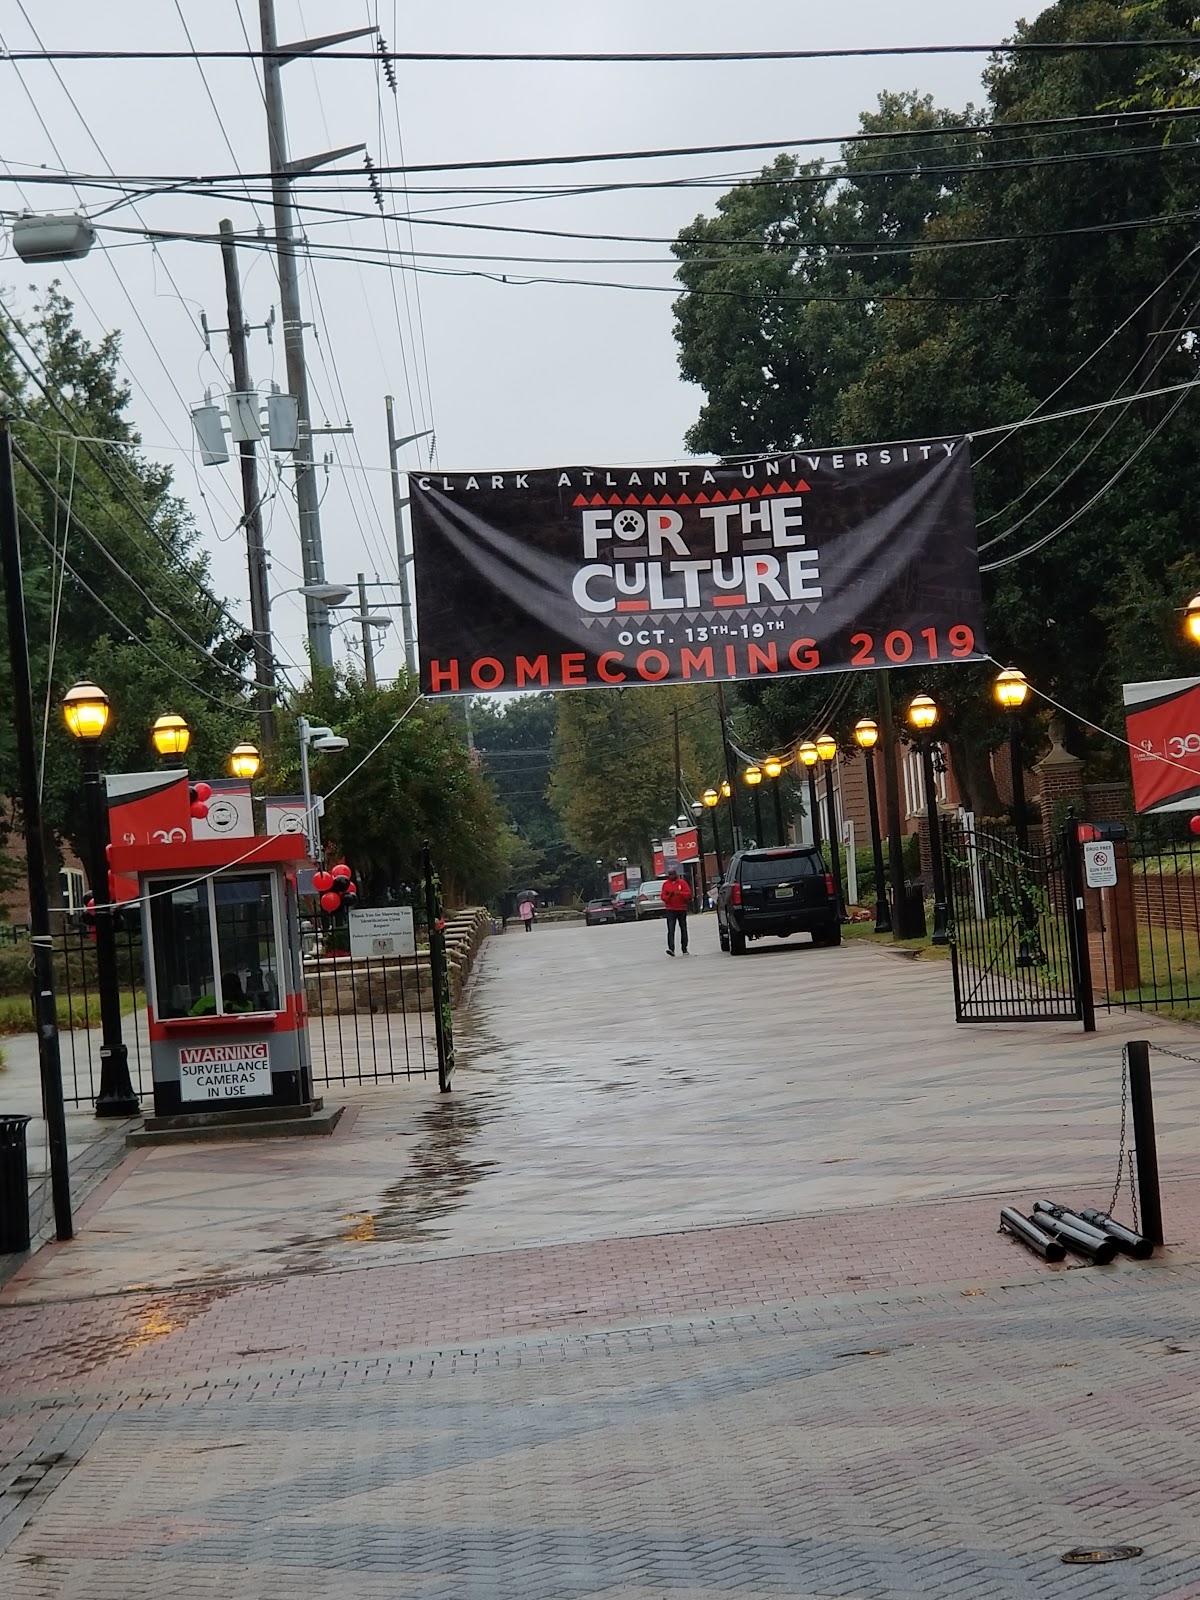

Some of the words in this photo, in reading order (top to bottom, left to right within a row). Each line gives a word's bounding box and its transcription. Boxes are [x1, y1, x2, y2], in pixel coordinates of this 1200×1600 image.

[418, 473, 529, 491] CLARK
[557, 470, 716, 487] ATLANTA
[742, 442, 956, 479] UNIVERSITY
[582, 509, 691, 559] FOR
[700, 496, 806, 554] THE
[572, 549, 823, 613] CULTURE
[618, 629, 674, 646] OCT.
[430, 637, 820, 692] HOMECOMING
[850, 624, 975, 666] 2019
[184, 1044, 265, 1063] WARNING
[182, 1060, 268, 1076] SURVEILLANCE
[196, 1072, 256, 1086] CAMERAS
[208, 1087, 219, 1097] IN
[224, 1085, 246, 1096] USE
